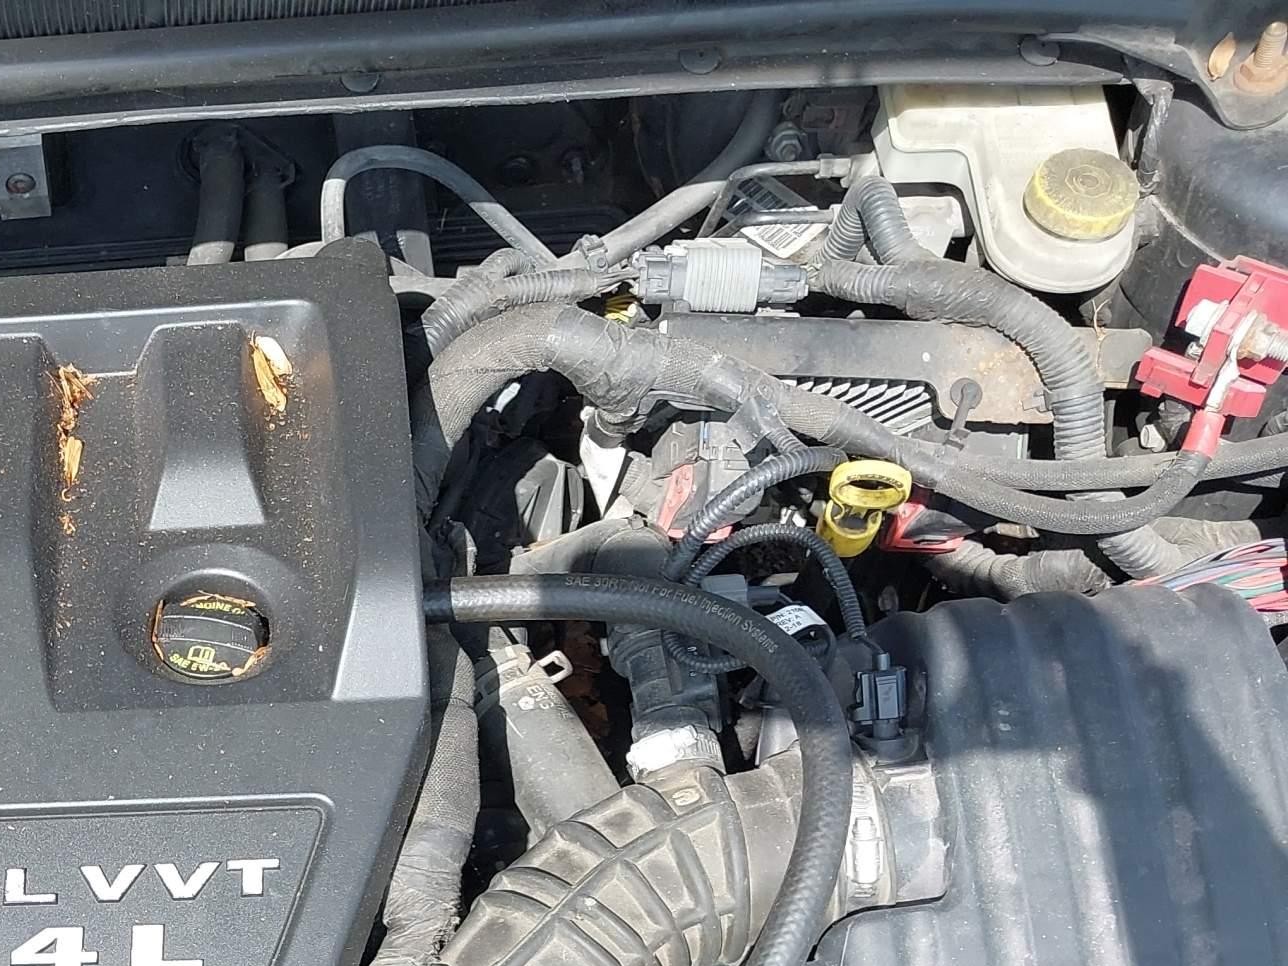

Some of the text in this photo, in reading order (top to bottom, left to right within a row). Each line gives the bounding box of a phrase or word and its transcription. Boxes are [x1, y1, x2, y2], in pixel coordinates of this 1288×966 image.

[564, 576, 591, 587] SAE
[652, 586, 673, 598] For
[673, 588, 701, 606] Fuel
[700, 597, 743, 626] Injection
[740, 619, 779, 653] Systems
[169, 653, 192, 669] SAE
[79, 858, 280, 903] VVT
